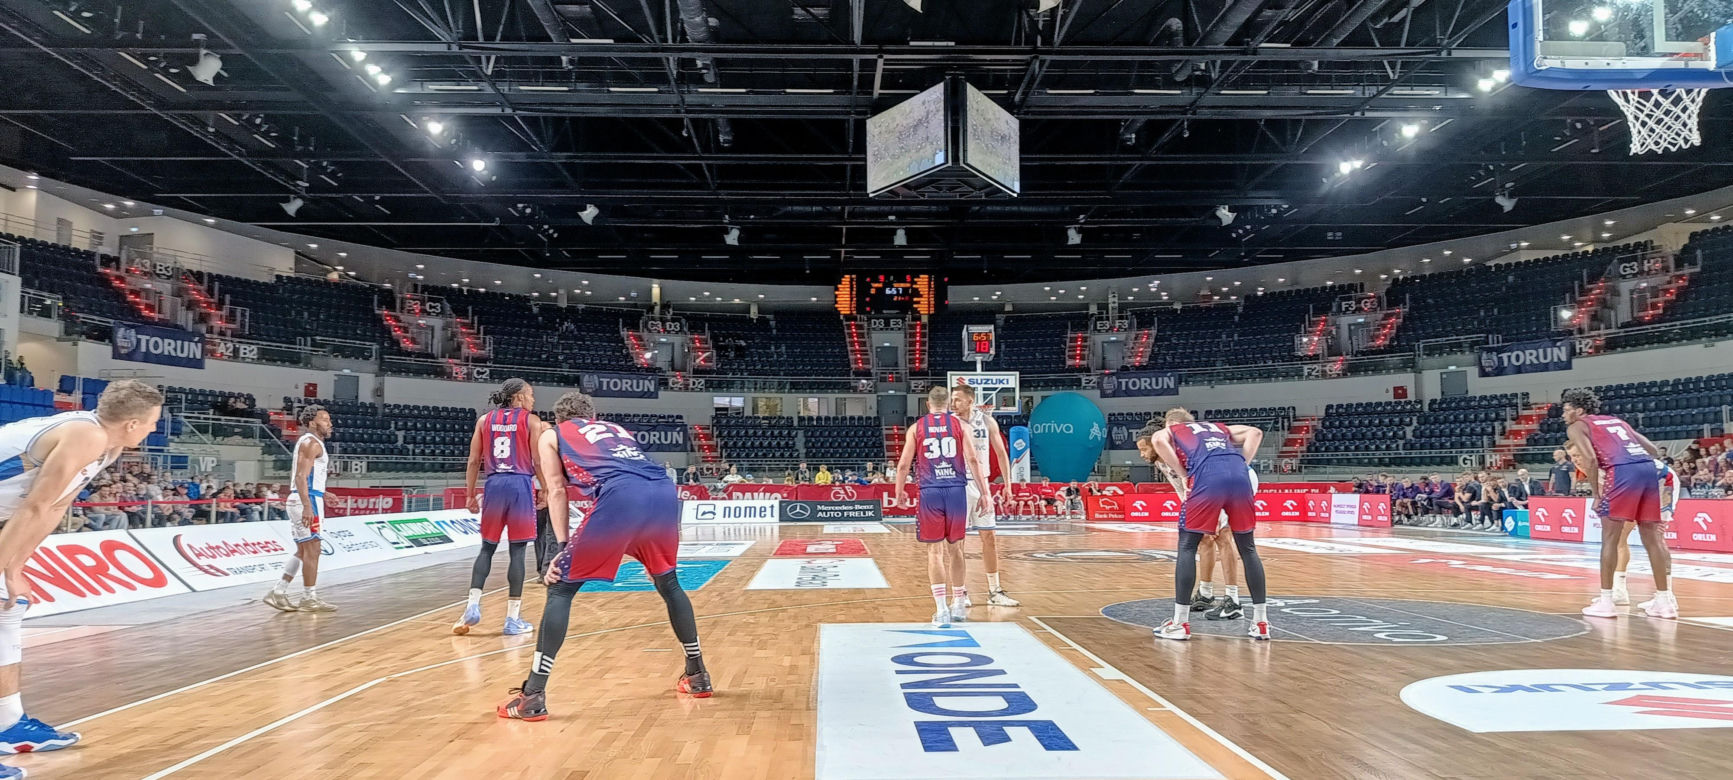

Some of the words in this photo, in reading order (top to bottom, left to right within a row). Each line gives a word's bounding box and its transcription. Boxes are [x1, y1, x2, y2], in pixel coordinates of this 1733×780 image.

[133, 259, 150, 271] A3
[156, 262, 173, 275] B3
[1619, 262, 1638, 275] G3
[1644, 258, 1662, 271] H3
[426, 302, 441, 313] C3
[1341, 301, 1356, 311] F3
[648, 321, 661, 330] C3
[666, 322, 680, 331] D3
[871, 319, 885, 328] D3
[890, 319, 903, 328] E3
[1097, 321, 1110, 330] E3
[1115, 320, 1128, 329] F3
[137, 335, 203, 359] TORUŃ
[218, 342, 234, 356] A2
[239, 345, 257, 359] B2
[976, 341, 990, 353] 18
[1576, 339, 1592, 353] H2
[473, 368, 490, 379] C2
[1303, 365, 1319, 377] F2
[600, 376, 655, 392] TORUŃ
[689, 378, 704, 389] D2
[912, 381, 925, 391] E2
[968, 378, 1009, 386] SUZUKI
[1082, 376, 1098, 387] E2
[1119, 373, 1175, 391] TORUŃ
[1033, 420, 1074, 434] arriva
[1186, 423, 1225, 435] 11
[577, 423, 637, 445] 21
[633, 427, 684, 445] ORUŃ
[973, 429, 987, 439] 31
[494, 436, 511, 459] 8
[923, 436, 957, 460] 30
[1460, 454, 1475, 468] G1
[352, 461, 368, 474] B1
[703, 463, 717, 475] C1
[935, 468, 956, 476] KING
[722, 504, 776, 519] nomet
[1664, 532, 1678, 540] LEN
[1692, 533, 1717, 542] ORLEN
[187, 538, 285, 560] AutoAndreas
[22, 540, 168, 604] NIRO
[1447, 680, 1733, 695] SUZUKI
